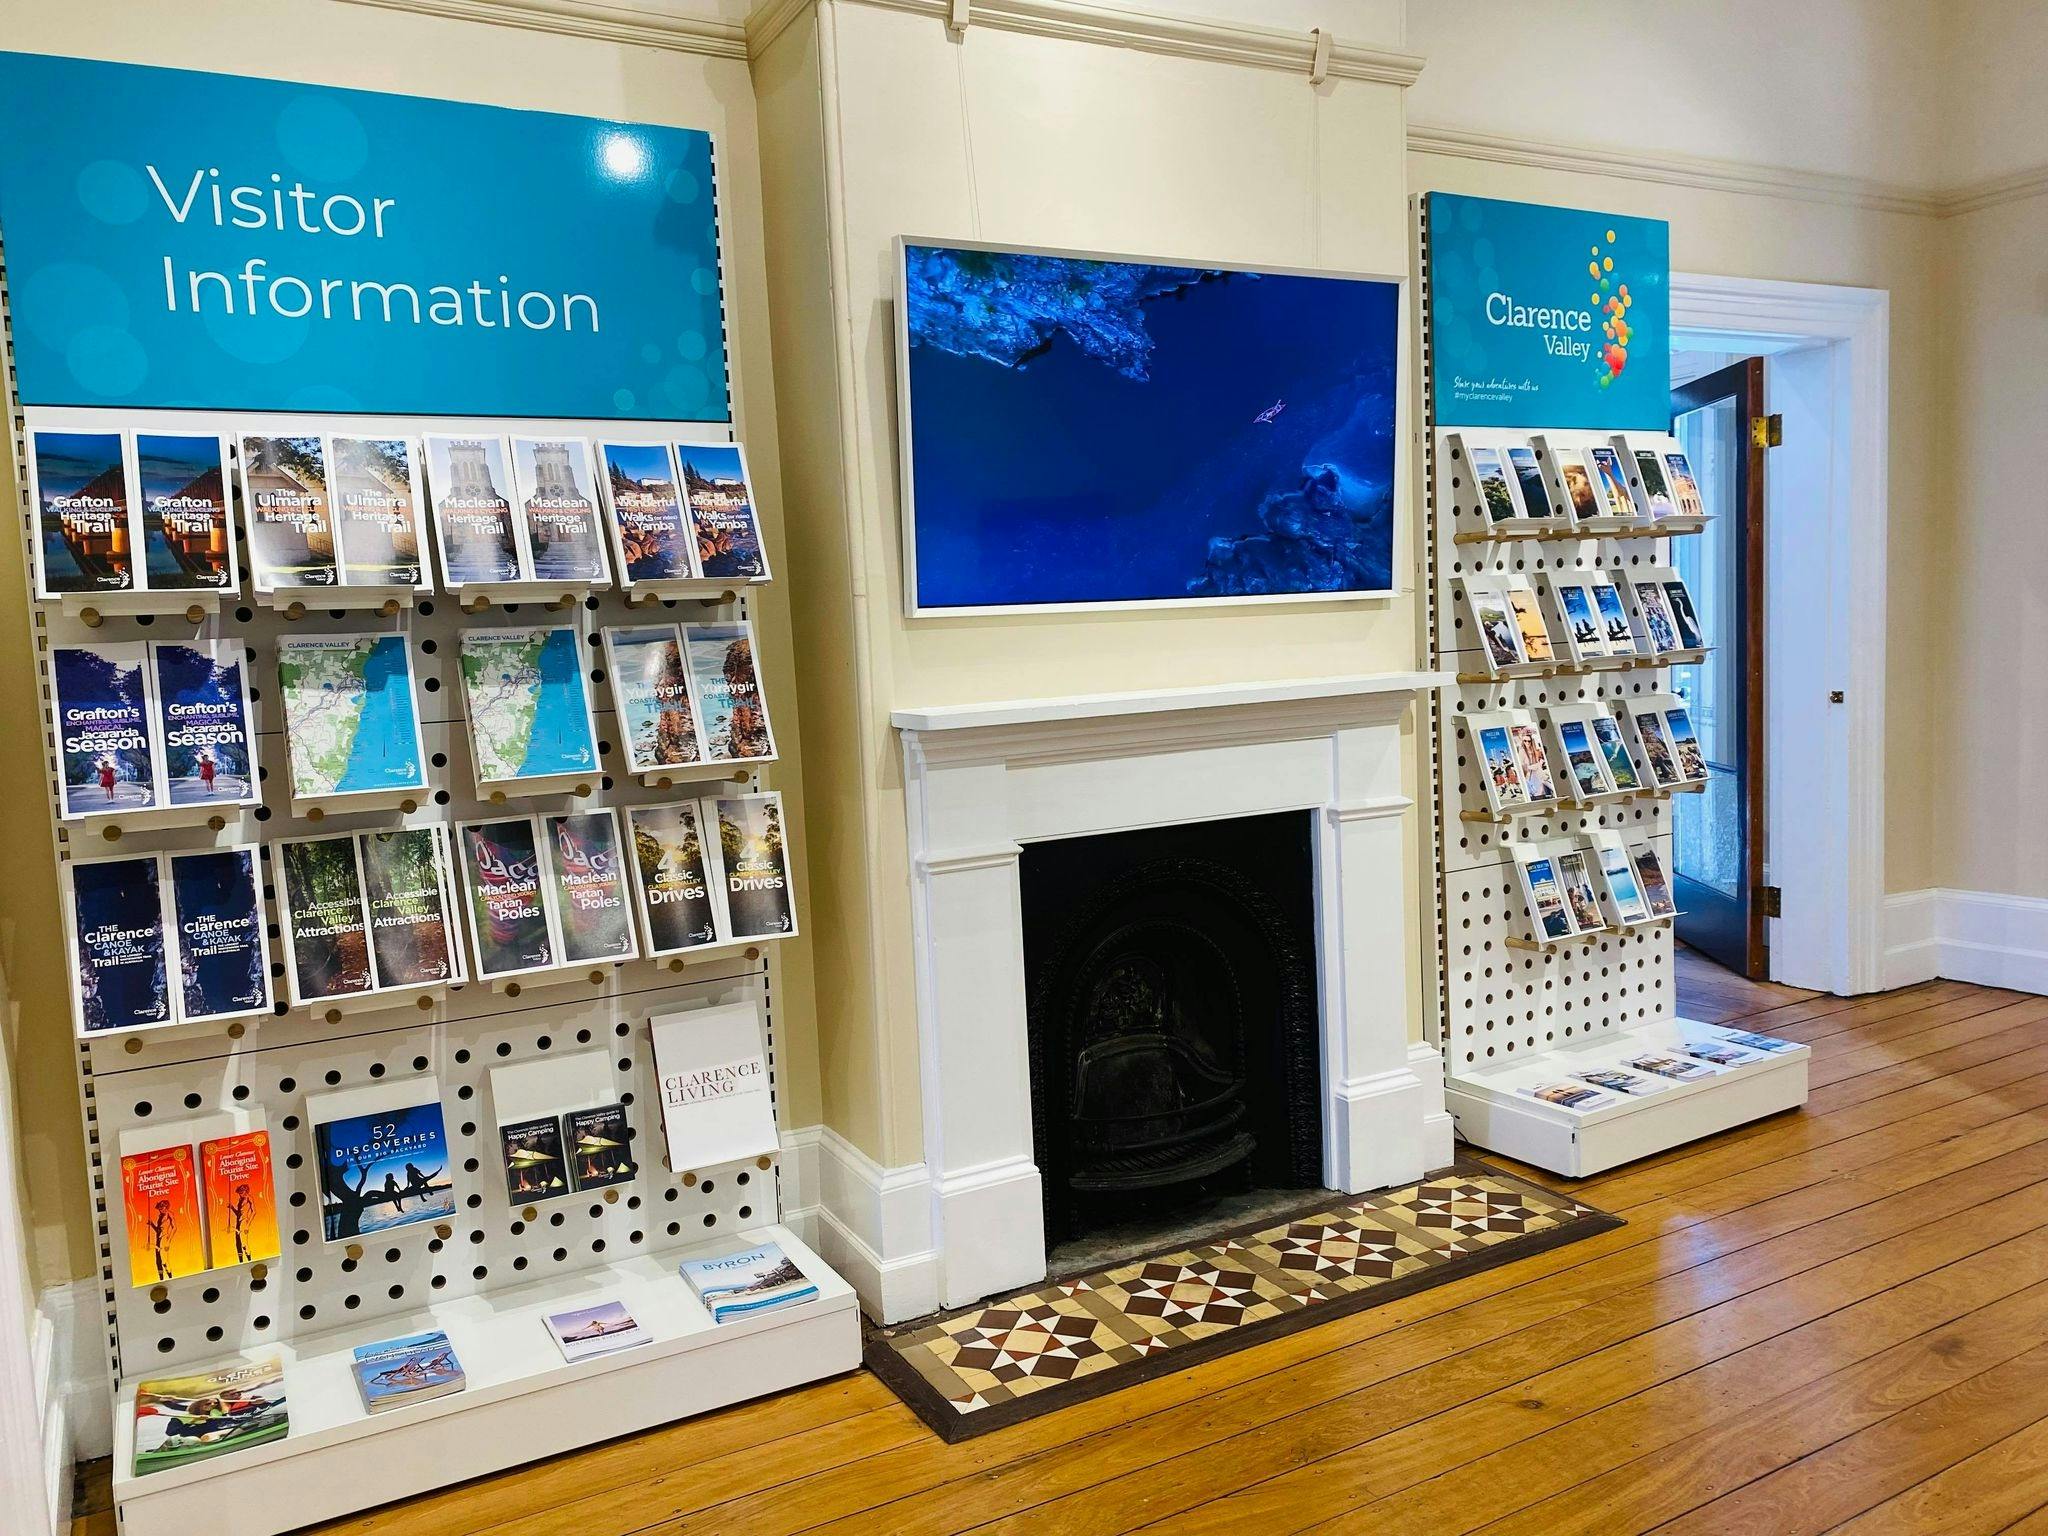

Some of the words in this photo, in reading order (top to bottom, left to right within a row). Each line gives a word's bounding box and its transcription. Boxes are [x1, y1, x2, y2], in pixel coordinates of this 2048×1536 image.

[146, 165, 395, 238] Visitor
[164, 256, 599, 332] Information
[1486, 292, 1592, 332] Clarence
[1544, 335, 1590, 362] Valley
[1454, 392, 1513, 403] #myclarencevalley
[276, 488, 296, 497] The
[362, 488, 382, 498] The
[54, 496, 114, 507] Grafton
[154, 496, 212, 508] Grafton
[258, 494, 322, 507] Ulmarra
[346, 494, 406, 507] Ulmarra
[445, 497, 505, 508] Maclean
[530, 497, 588, 508] Maclean
[616, 496, 676, 507] Wonderful
[690, 496, 748, 506] Wonderful
[61, 511, 111, 521] Heritage
[162, 511, 211, 522] Heritage
[265, 512, 320, 523] Heritage
[352, 511, 404, 523] Heritage
[447, 513, 498, 525] Heritage
[533, 513, 581, 523] Heritage
[620, 511, 654, 522] Walks
[694, 510, 727, 521] Walks
[74, 519, 115, 533] Trail
[174, 518, 213, 533] Trail
[291, 520, 327, 534] Trail
[376, 520, 411, 534] Trail
[472, 522, 505, 534] Trail
[556, 521, 588, 534] Trail
[635, 521, 675, 531] Yamba
[709, 519, 748, 530] Yamba
[626, 683, 684, 698] Yuaygir
[66, 706, 140, 721] Grafton's
[168, 701, 238, 716] Grafton's
[79, 728, 139, 740] Jacaranda
[85, 724, 124, 732] MAGICAL
[180, 722, 237, 734] Jacaranda
[65, 736, 147, 753] Season
[167, 730, 244, 747] Season
[657, 850, 677, 873] 4
[736, 860, 774, 872] Classic
[561, 872, 617, 886] Maclean
[654, 869, 693, 884] Classic
[477, 881, 537, 897] Maclean
[730, 875, 784, 892] Drives
[386, 887, 438, 901] Accessible
[570, 889, 604, 899] Tartan
[648, 886, 705, 905] Drives
[308, 897, 361, 911] Accessible
[372, 897, 418, 909] Clarence
[486, 899, 523, 910] Tartan
[581, 896, 620, 910] Poles
[294, 907, 343, 919] Clarence
[397, 904, 430, 916] Valley
[499, 906, 540, 922] Poles
[196, 914, 216, 923] THE
[321, 914, 354, 926] Valley
[373, 912, 440, 928] Attractions
[98, 924, 119, 933] THE
[183, 916, 250, 934] Clarence
[295, 922, 365, 939] Attractions
[84, 926, 154, 944] Clarence
[193, 929, 230, 940] CANOE
[209, 935, 242, 946] KAYAK
[94, 939, 133, 951] CANOE
[103, 949, 111, 957] &
[111, 945, 145, 956] KAYAK
[190, 945, 218, 957] Trail
[91, 955, 120, 968] Trail
[665, 1061, 761, 1091] CLARENCE
[668, 1080, 734, 1104] LIVING
[595, 1114, 620, 1122] Camping
[373, 1123, 396, 1140] 52
[508, 1132, 528, 1140] Happy
[527, 1127, 554, 1136] Camping
[336, 1131, 436, 1158] DISCOVERIES
[390, 1143, 427, 1154] BACKYARD
[220, 1154, 256, 1167] Aboriginal
[138, 1170, 177, 1183] Aboriginal
[218, 1166, 244, 1176] Tourist
[230, 1173, 250, 1181] Drive
[137, 1182, 164, 1191] Tourist
[149, 1189, 170, 1197] Drive
[702, 1252, 765, 1271] BYRON
